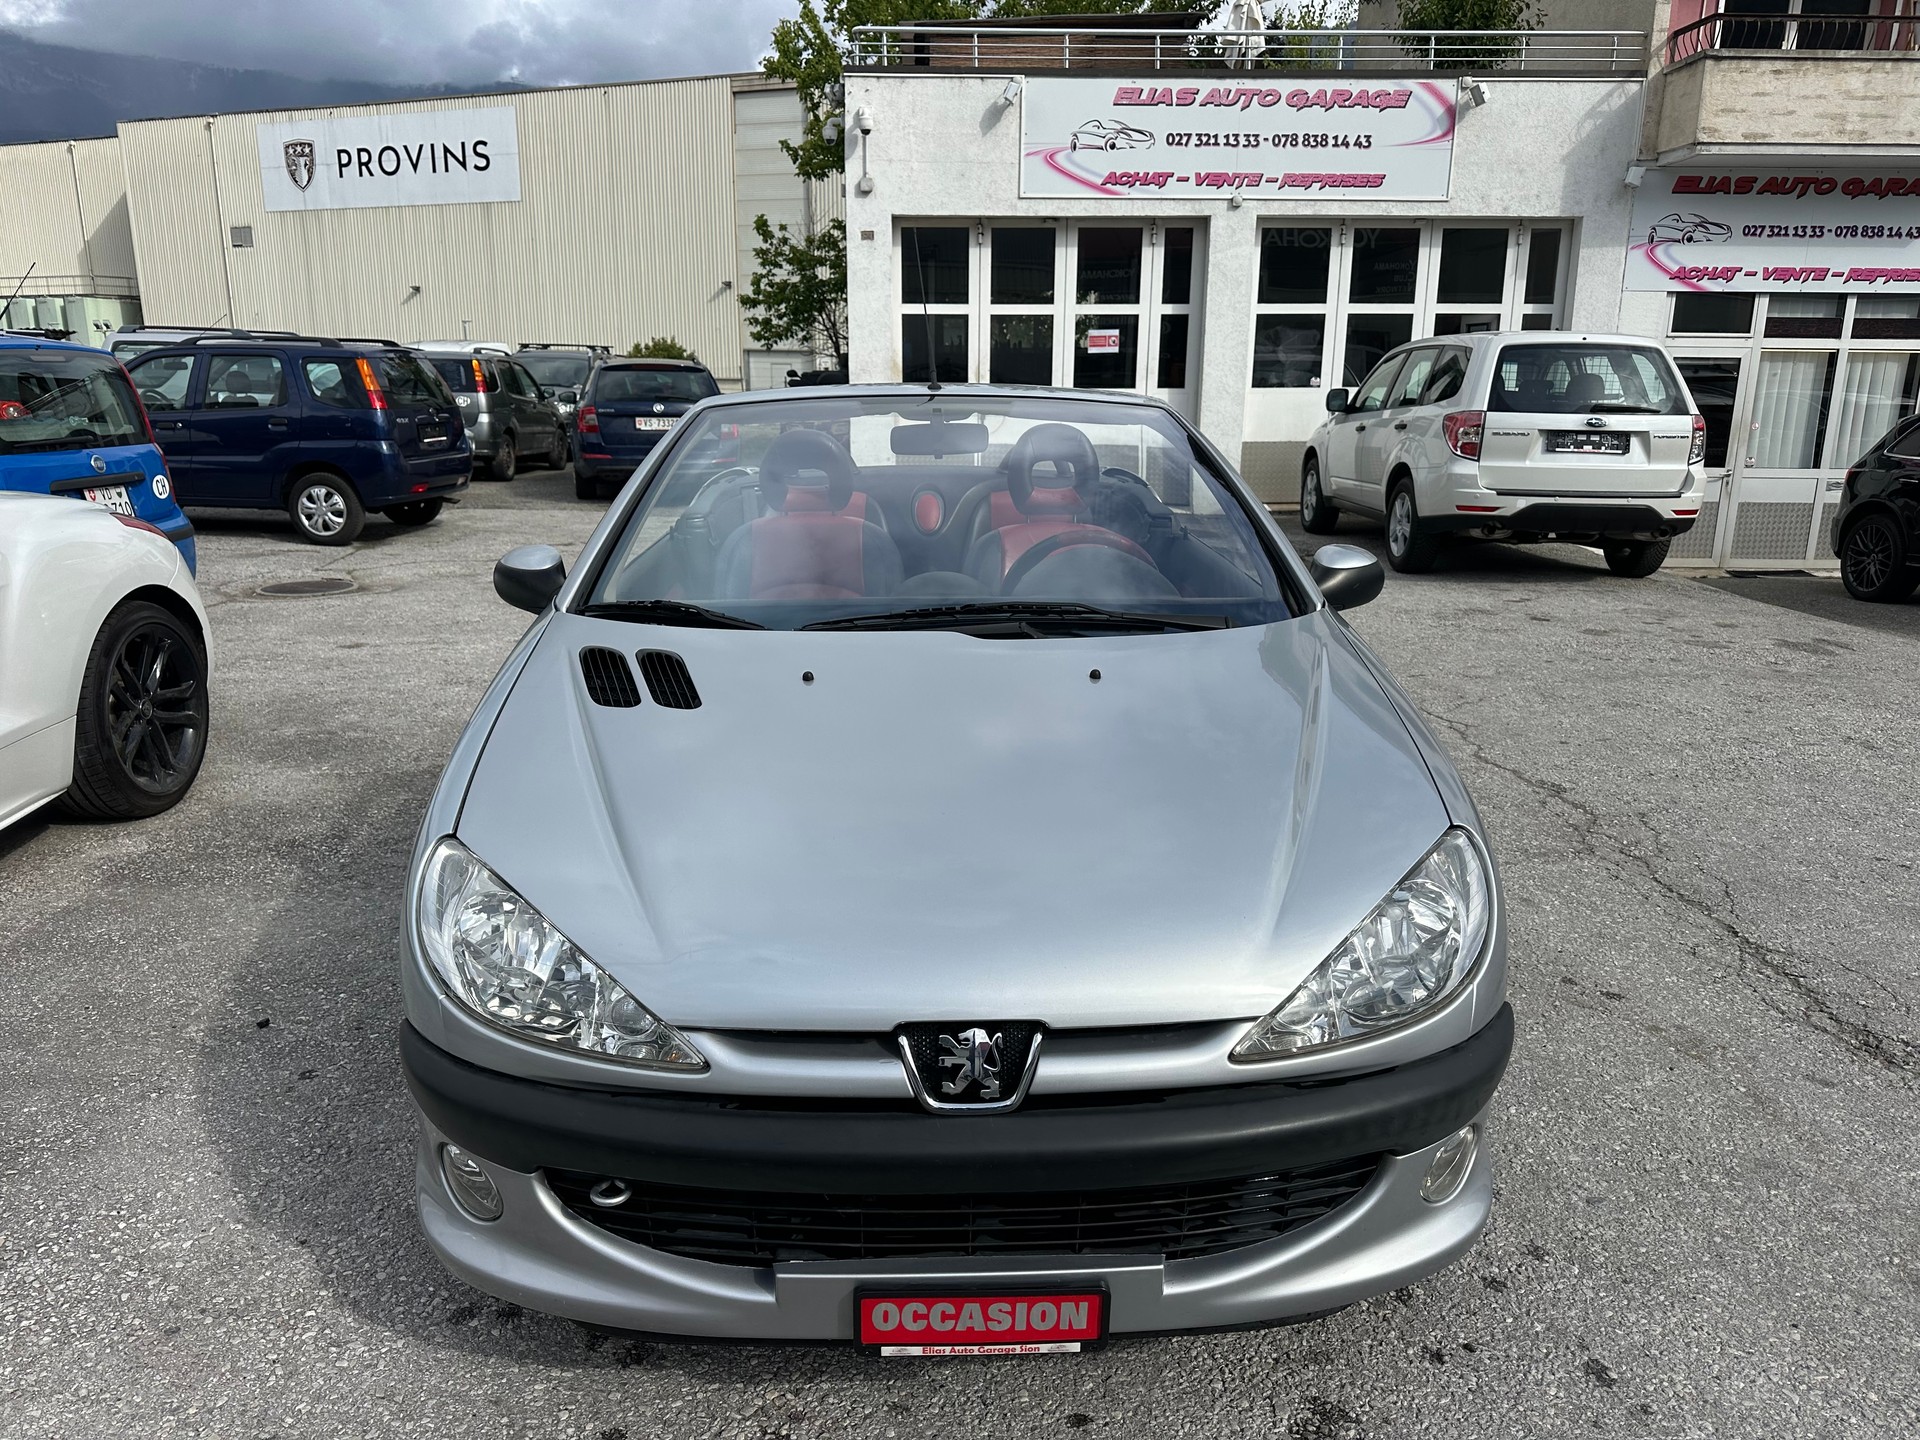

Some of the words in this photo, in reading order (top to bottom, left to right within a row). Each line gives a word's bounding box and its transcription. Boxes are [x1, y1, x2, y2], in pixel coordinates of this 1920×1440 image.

[1113, 87, 1198, 107] ELIAS
[1199, 88, 1280, 112] AUTO
[1285, 89, 1413, 112] GARAGE
[1166, 132, 1192, 148] 027
[1194, 132, 1220, 148] 321
[1224, 132, 1239, 148] 13
[1242, 132, 1260, 149] 33
[1272, 133, 1300, 149] 078
[1302, 133, 1329, 149] 838
[1332, 133, 1350, 149] 14
[1352, 133, 1373, 150] 43
[336, 140, 491, 179] PROVINS
[1100, 172, 1174, 188] ACHAT
[1194, 172, 1264, 189] VENTE
[1279, 173, 1386, 190] REPRISES
[1672, 175, 1757, 195] ELIAS
[1756, 176, 1838, 199] AUTO
[1742, 225, 1766, 238] 027
[1767, 225, 1789, 238] 321
[1792, 225, 1807, 238] 13
[1808, 225, 1825, 239] 33
[1834, 225, 1858, 239] 078
[1860, 225, 1885, 239] 838
[1886, 226, 1903, 239] 14
[1905, 226, 1920, 239] 43
[1669, 266, 1743, 283] ACHAT
[1762, 267, 1830, 283] VENTE
[99, 487, 112, 500] VD
[155, 477, 168, 496] CH
[104, 501, 132, 517] 710
[871, 1301, 1089, 1332] OCCASION
[922, 1346, 946, 1355] Elias
[949, 1346, 975, 1355] Auto
[977, 1346, 1017, 1355] Garage
[1019, 1345, 1041, 1353] Sion
